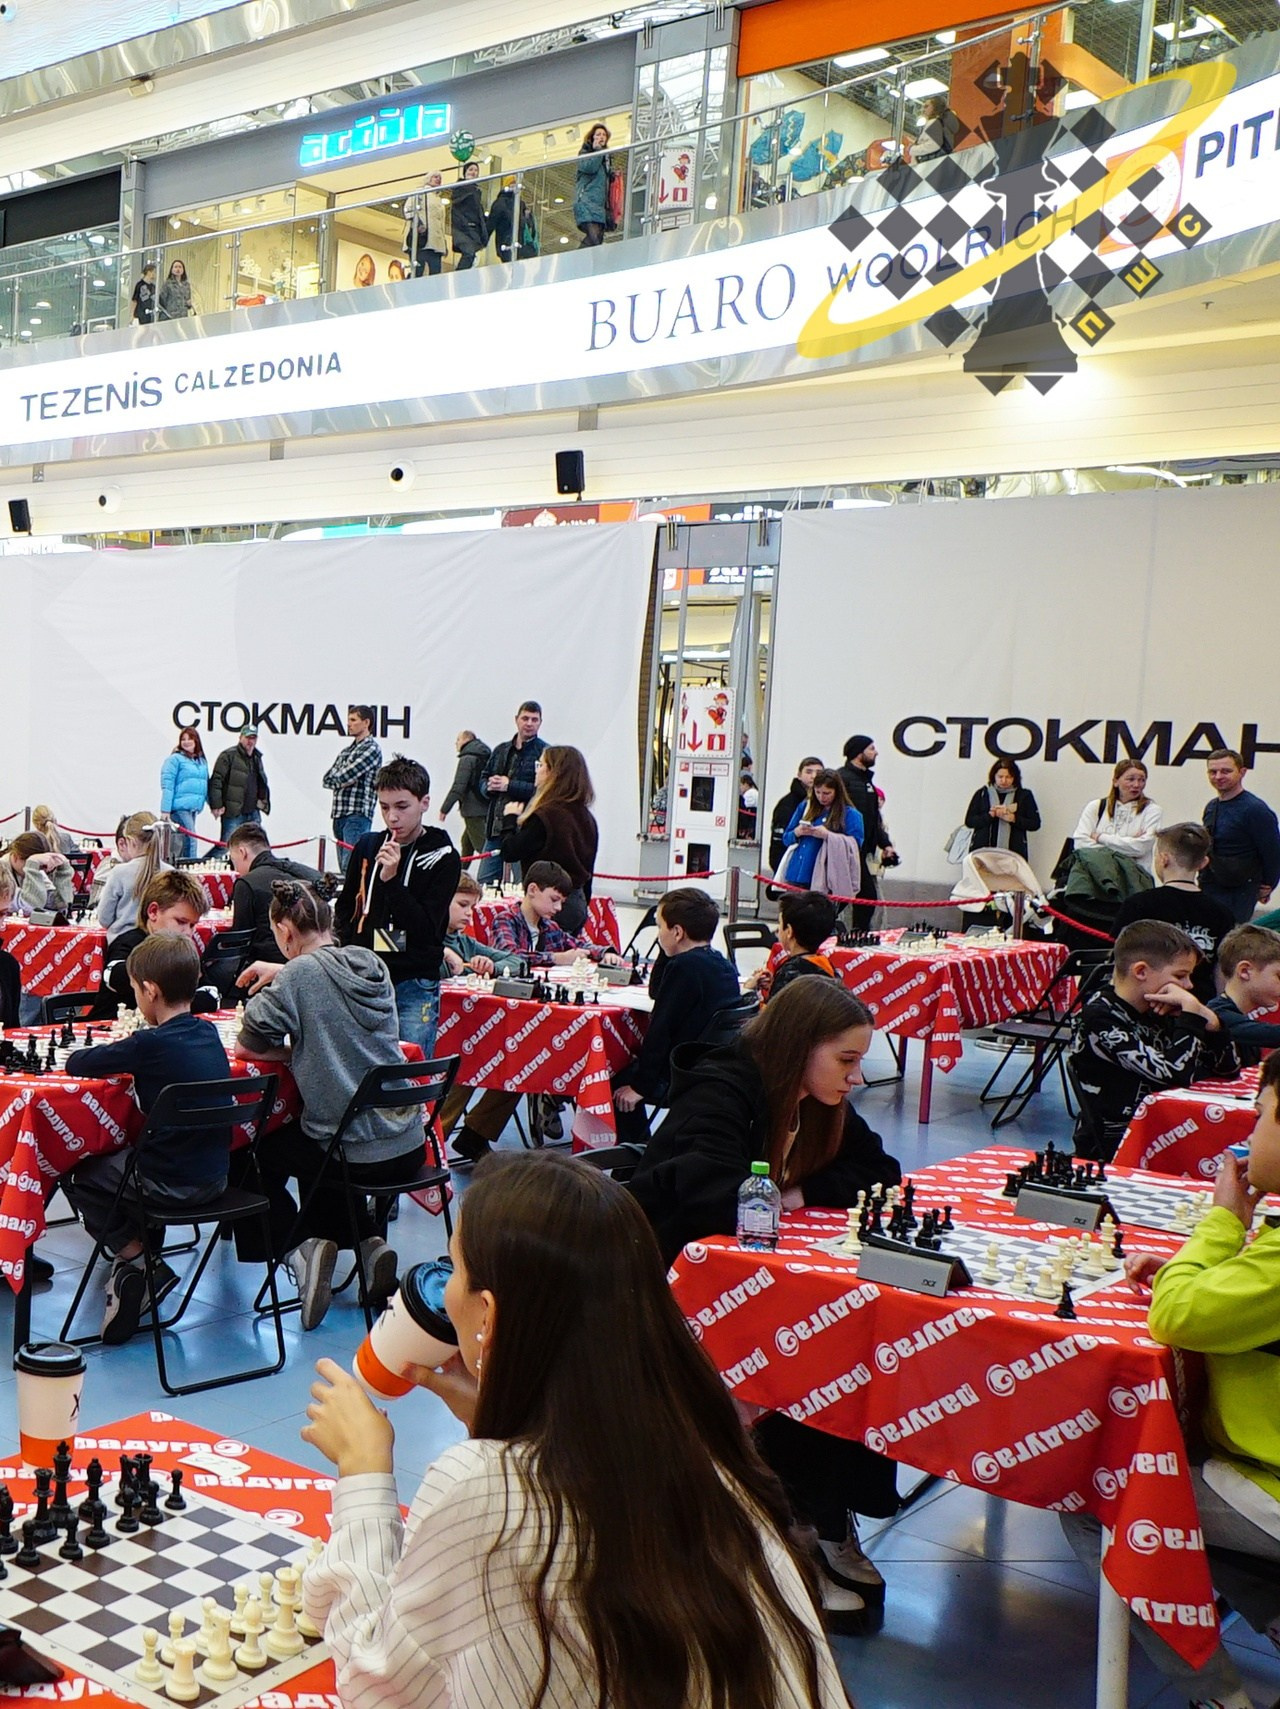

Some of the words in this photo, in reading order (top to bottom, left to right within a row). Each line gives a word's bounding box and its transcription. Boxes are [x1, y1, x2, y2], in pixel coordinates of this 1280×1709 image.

[826, 198, 1078, 296] WOOLRICH
[586, 262, 797, 352] BUARO
[174, 351, 342, 394] CALZEDONIA
[696, 1266, 776, 1328] радуга
[793, 1283, 881, 1342] радуга
[892, 1307, 997, 1359] радуга
[1008, 1333, 1121, 1382] радуга
[789, 1362, 873, 1422] радуга
[880, 1382, 980, 1443] радуга
[74, 1437, 217, 1454] радуга
[994, 1408, 1103, 1469] радуга
